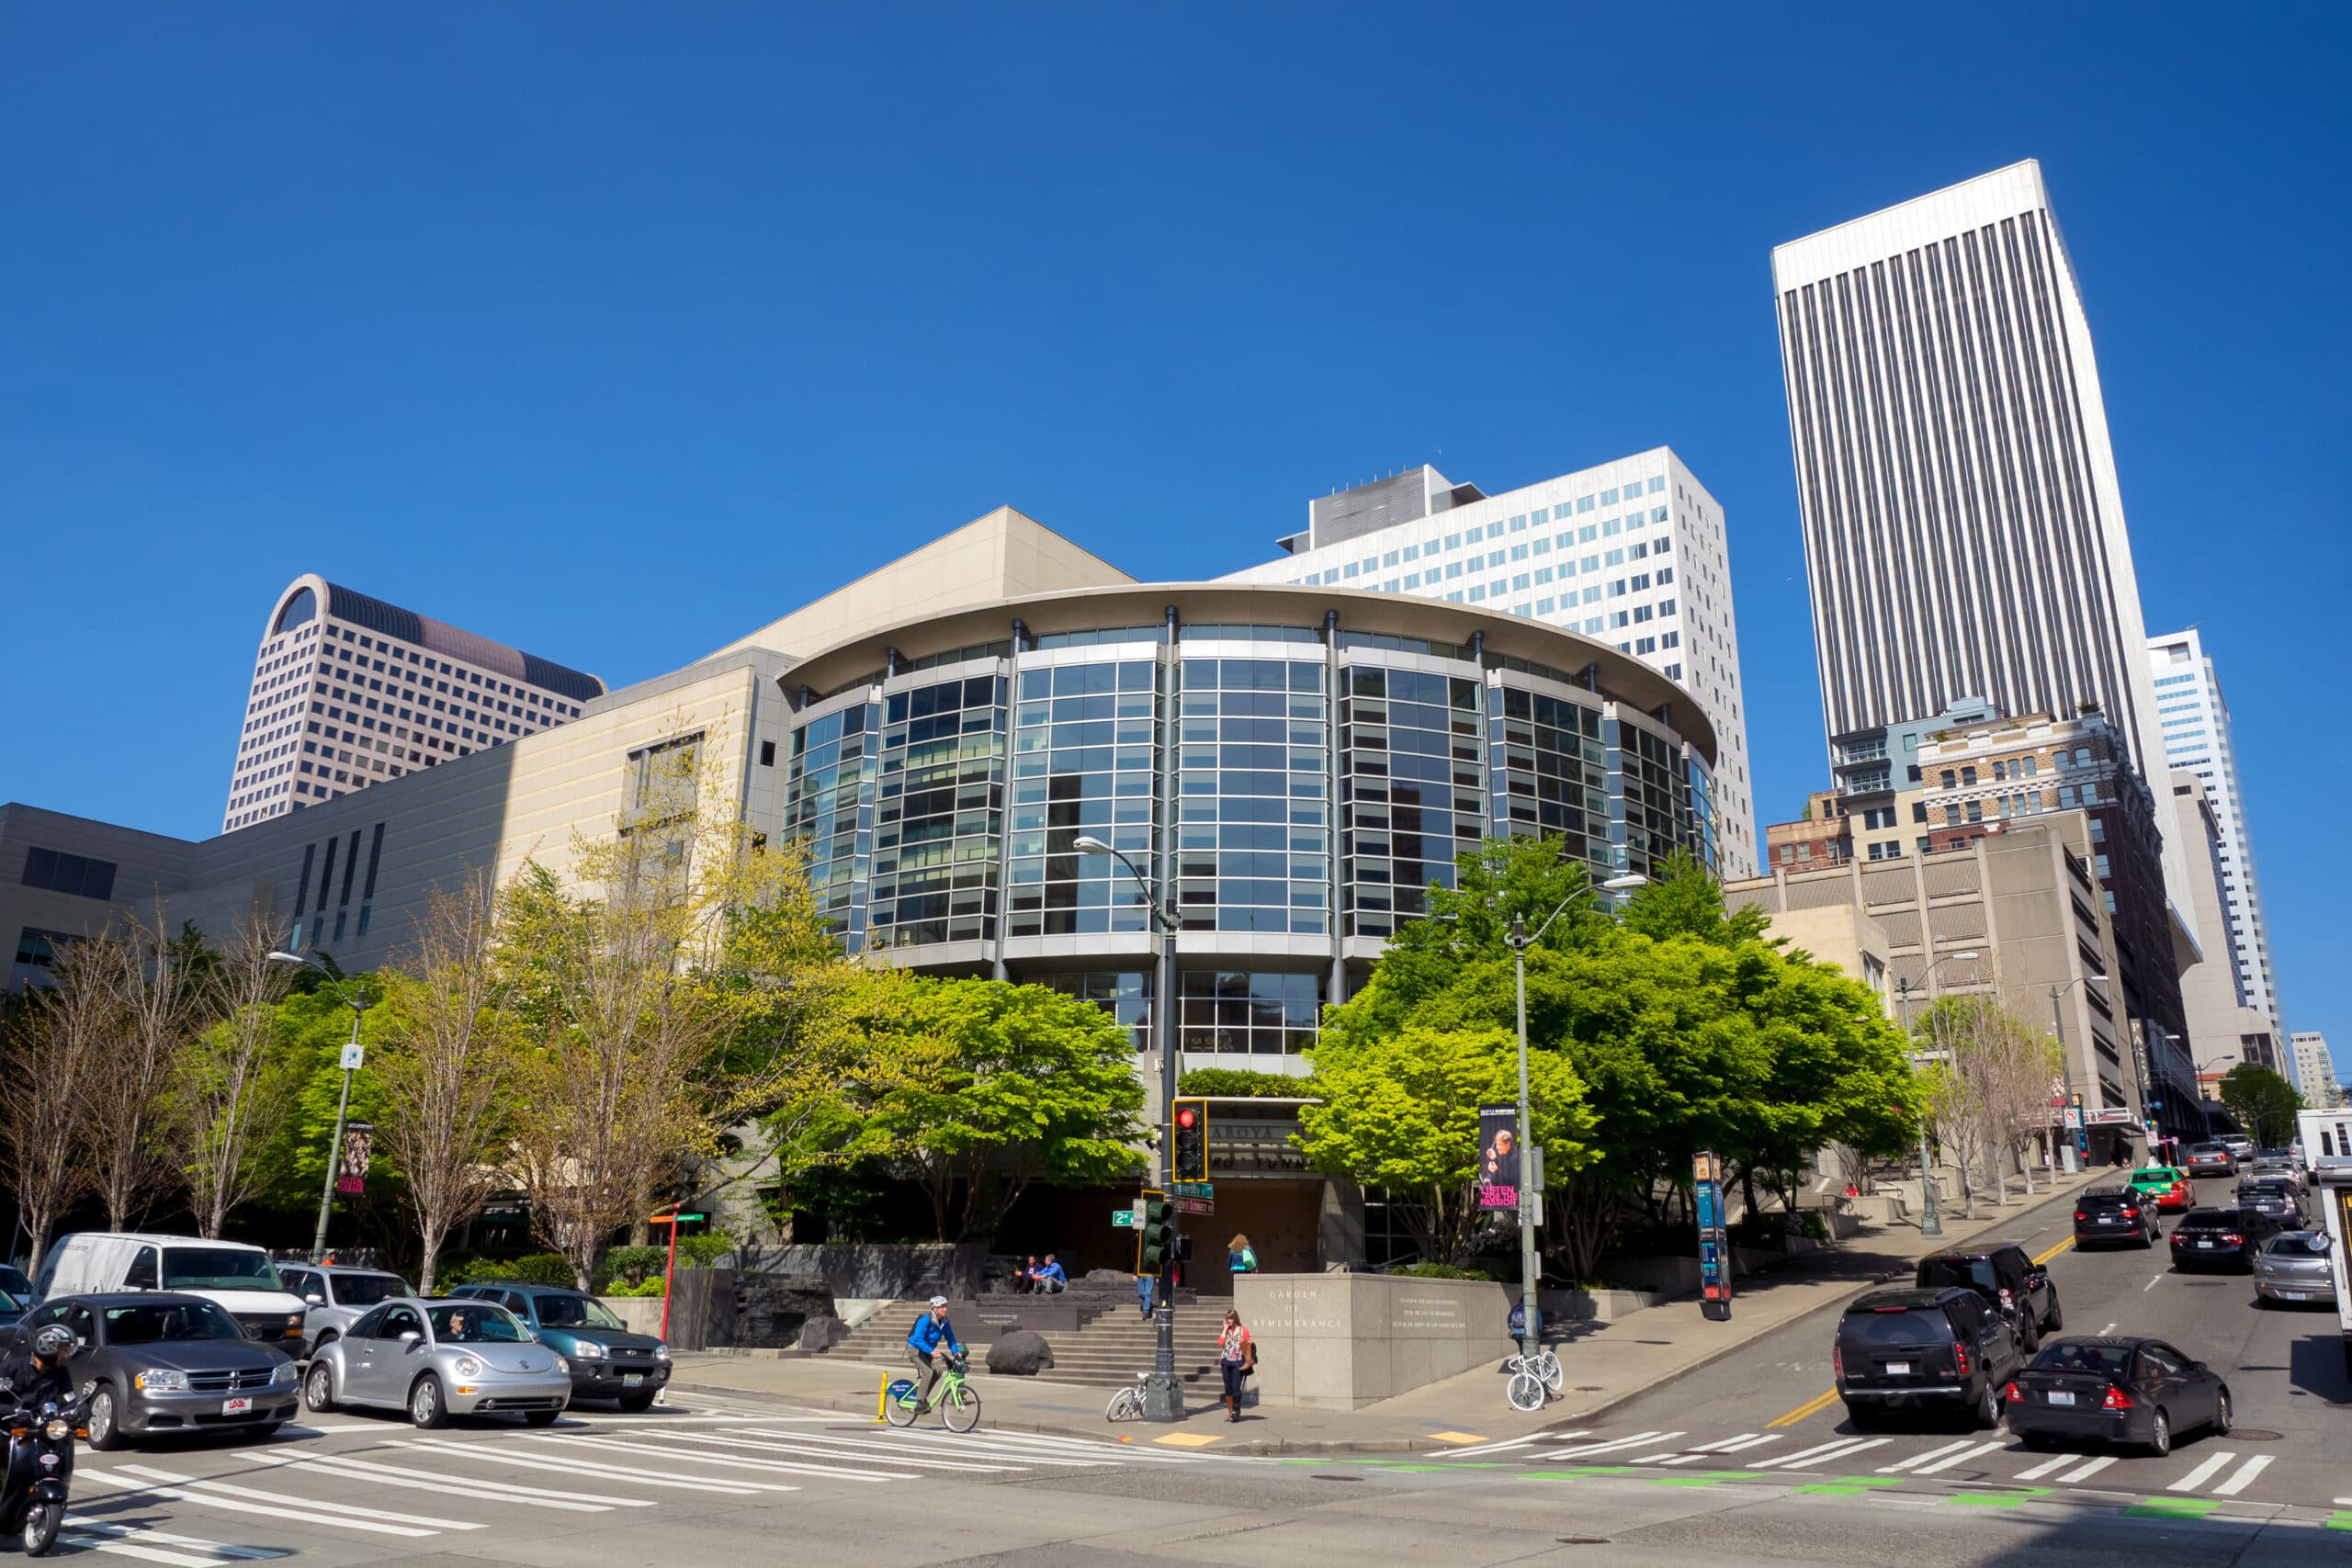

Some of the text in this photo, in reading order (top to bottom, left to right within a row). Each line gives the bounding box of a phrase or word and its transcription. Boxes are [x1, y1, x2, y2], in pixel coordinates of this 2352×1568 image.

[1480, 1185, 1515, 1195] LISTEN
[1270, 1291, 1317, 1300] GARDEN
[1284, 1304, 1298, 1314] OF
[1252, 1319, 1341, 1328] REMEMBRANCE
